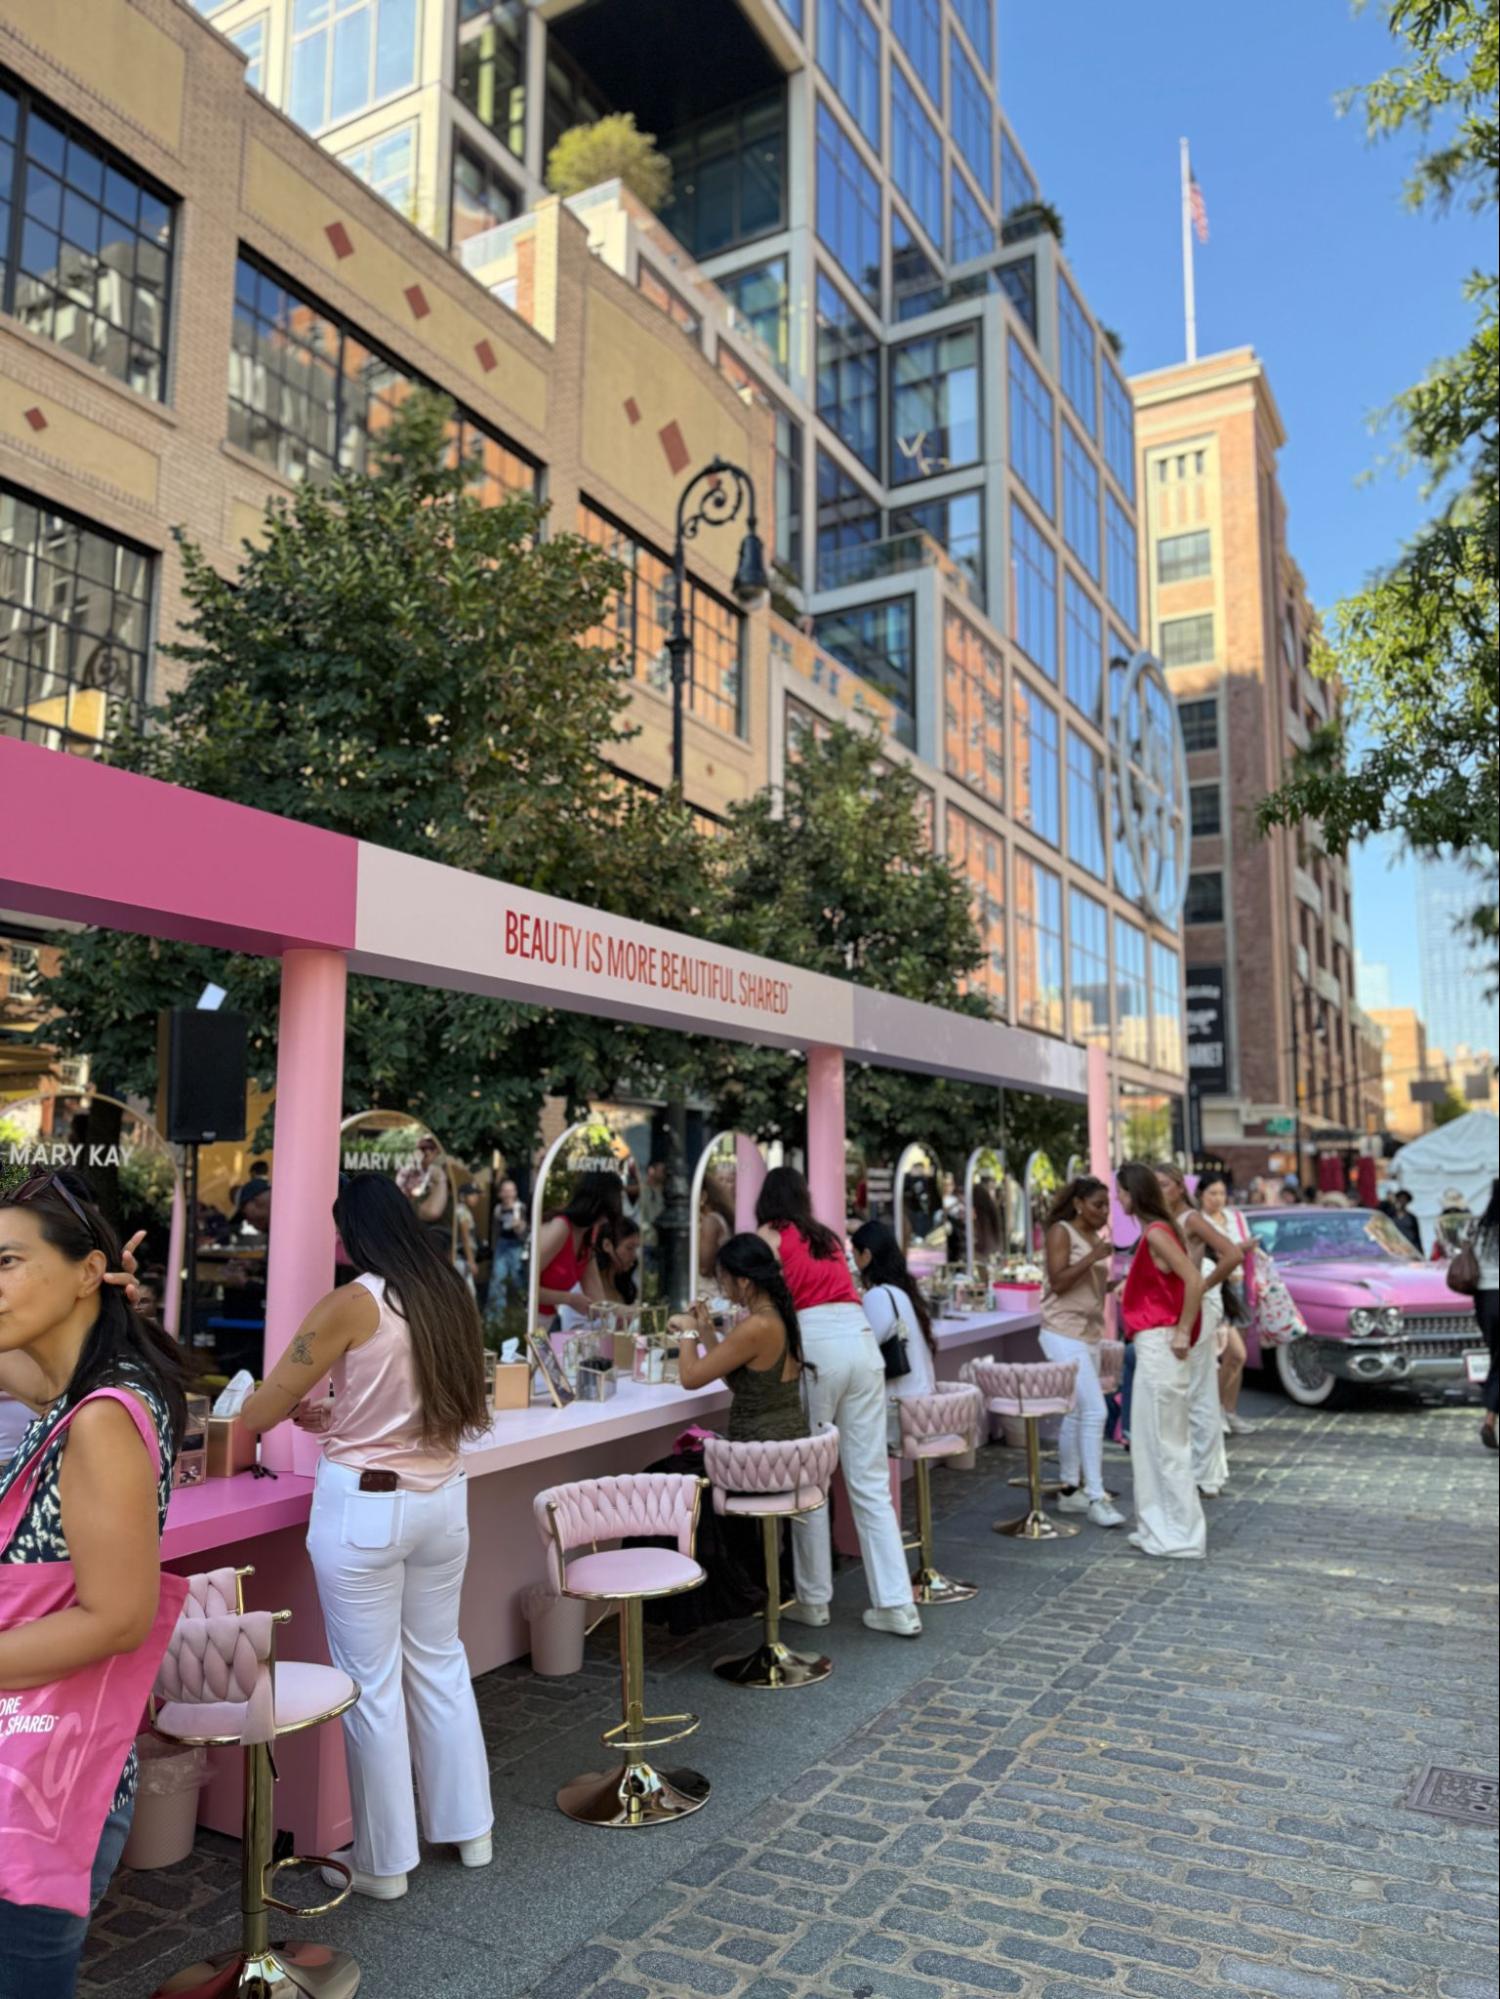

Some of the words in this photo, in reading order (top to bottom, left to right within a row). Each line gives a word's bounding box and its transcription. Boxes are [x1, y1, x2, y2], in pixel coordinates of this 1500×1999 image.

[505, 909, 582, 969] BEAUTY
[586, 931, 603, 974] IS
[608, 936, 657, 986] MORE
[661, 950, 736, 1004] BEAUTIFUL
[9, 1142, 84, 1166] MARY
[88, 1144, 134, 1167] KAY
[344, 1151, 391, 1171] MARY
[394, 1151, 422, 1171] KAY
[0, 1696, 23, 1717] ORE
